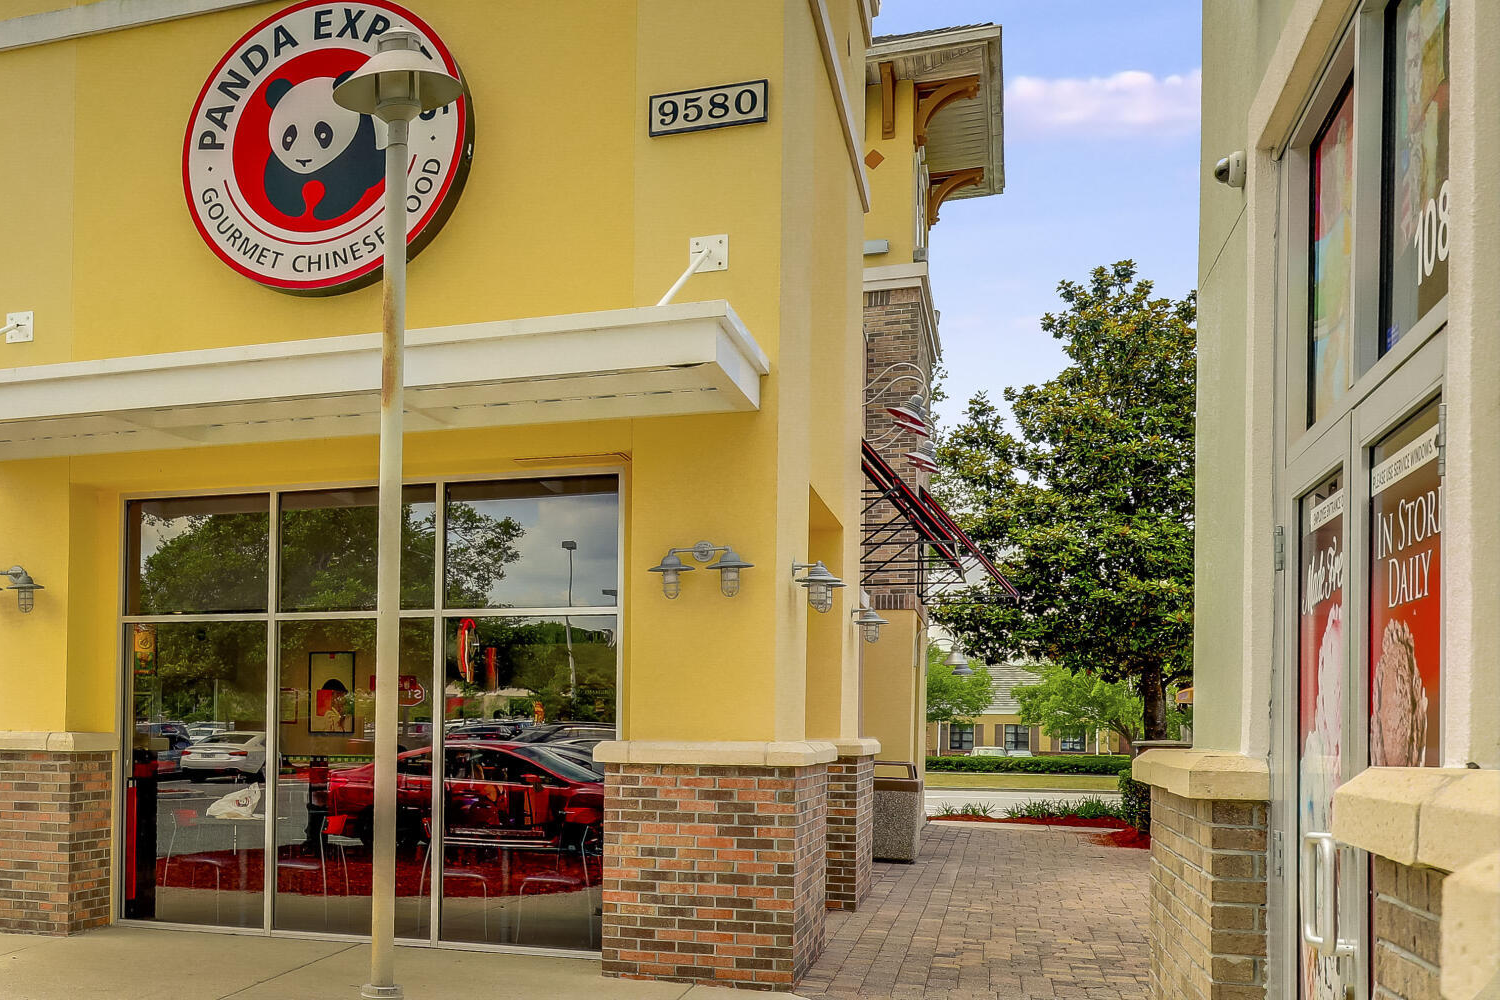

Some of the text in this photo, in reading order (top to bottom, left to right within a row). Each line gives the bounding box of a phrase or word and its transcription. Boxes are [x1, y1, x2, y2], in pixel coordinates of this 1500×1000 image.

[198, 24, 299, 151] PANDA
[658, 88, 758, 126] 9580
[202, 187, 284, 269] GOURMET
[406, 158, 441, 213] OOD
[1414, 179, 1450, 287] 108
[1377, 512, 1394, 560] IN
[1301, 550, 1326, 616] Made
[1388, 549, 1432, 608] DAILY
